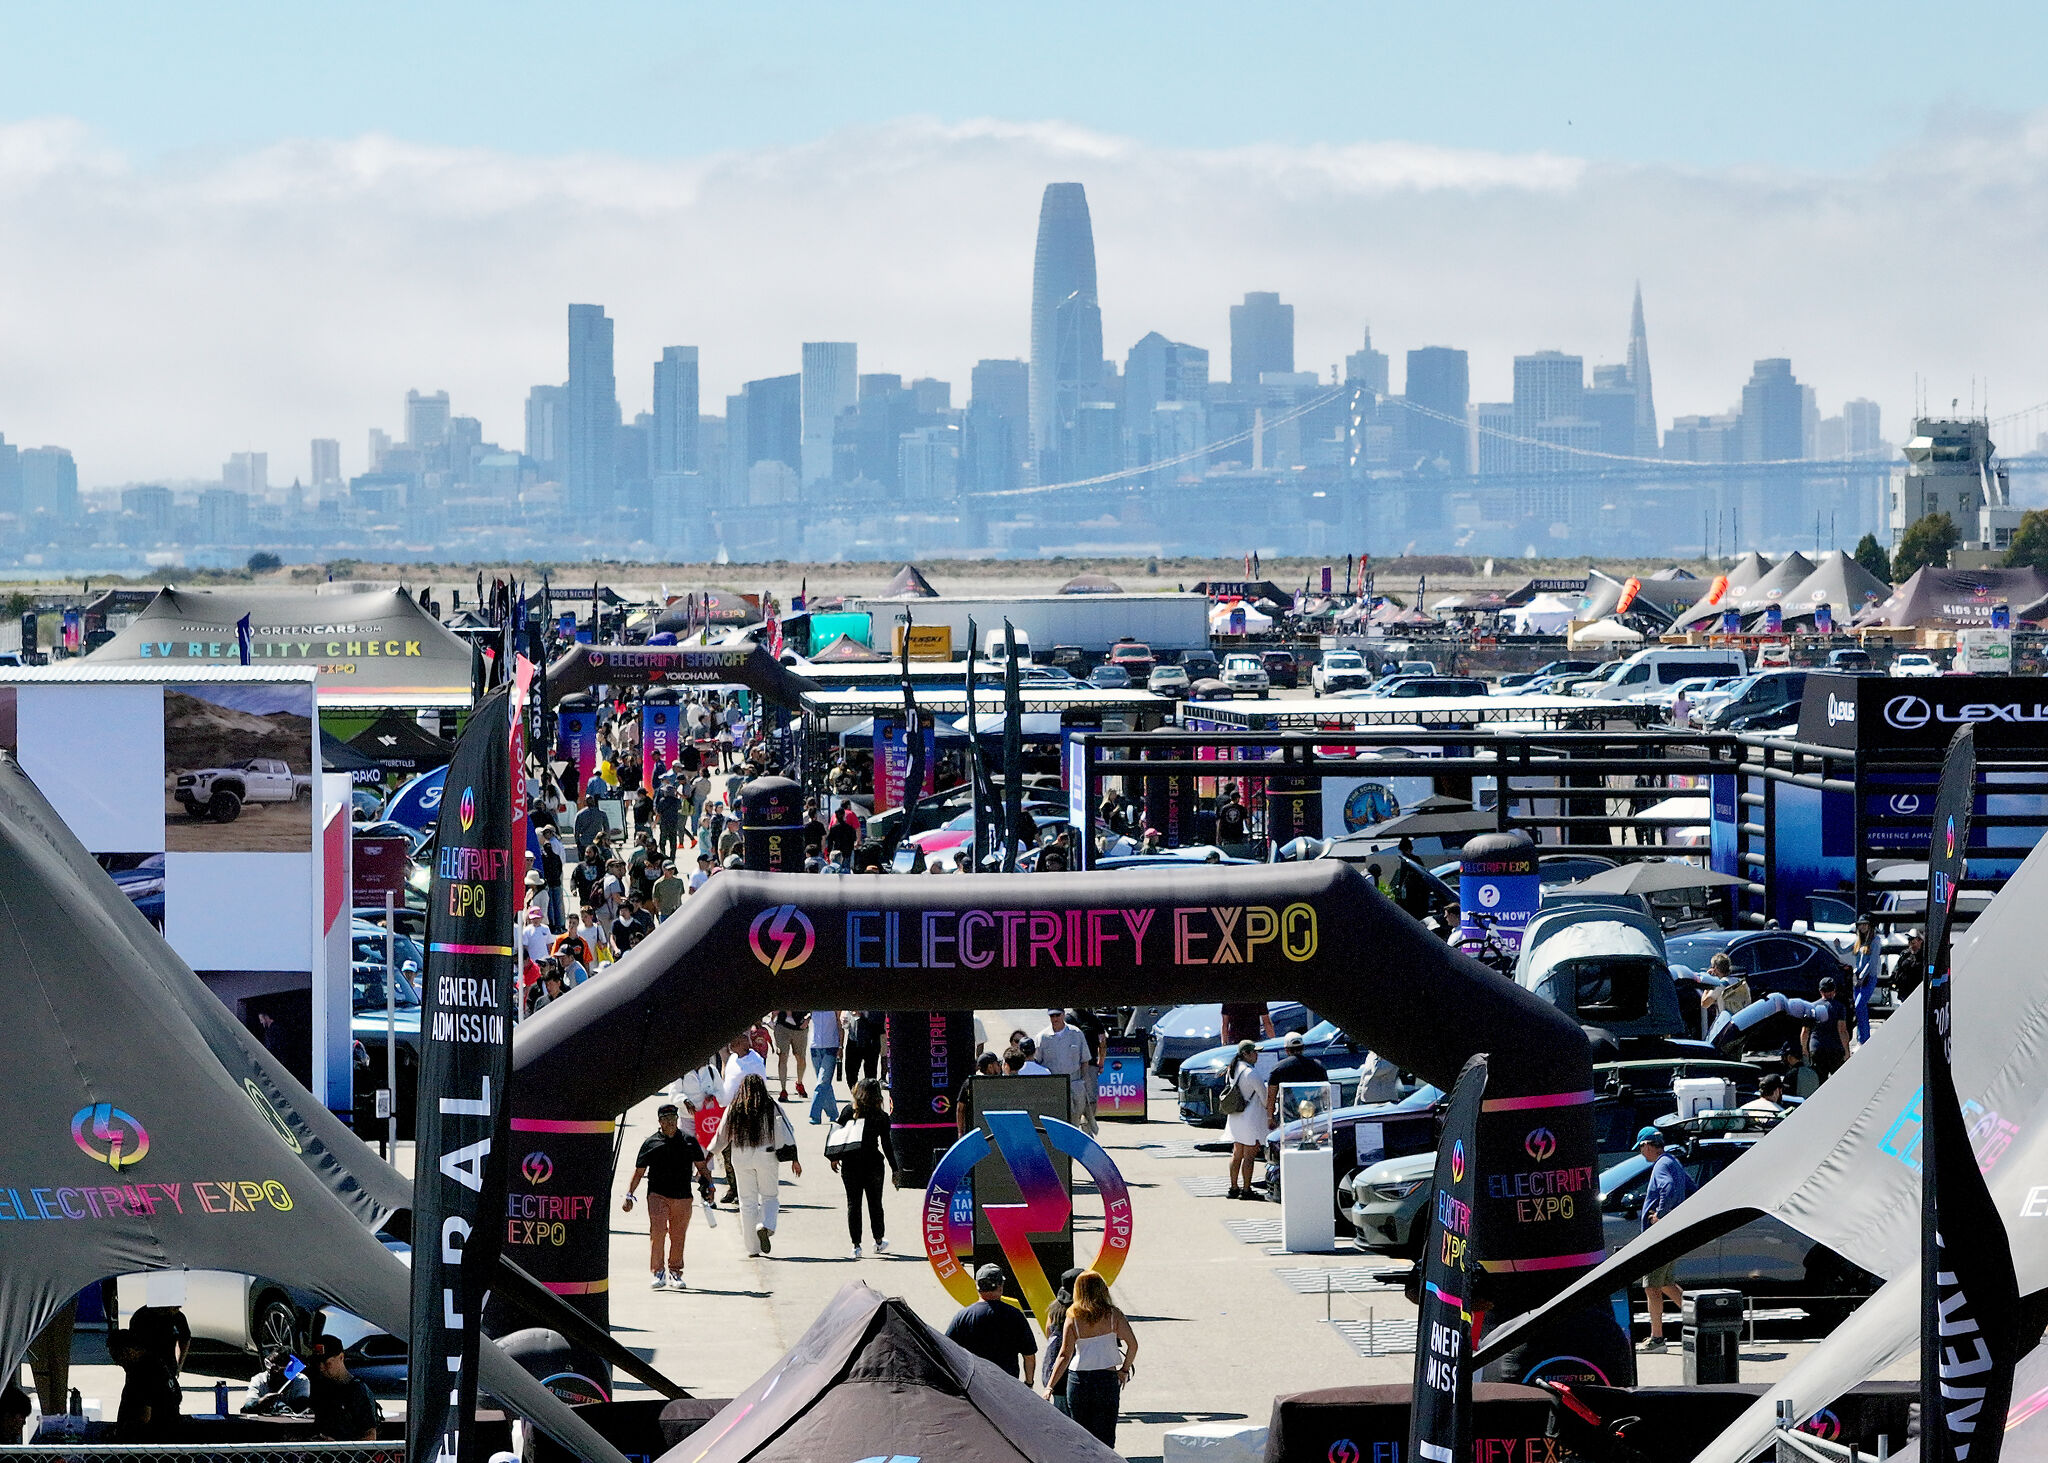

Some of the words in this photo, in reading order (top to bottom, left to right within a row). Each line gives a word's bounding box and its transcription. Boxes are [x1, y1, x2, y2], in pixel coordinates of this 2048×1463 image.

[1943, 605, 1971, 615] KIDS
[260, 625, 383, 635] GREENCARS.COM
[140, 642, 173, 657] EV
[326, 640, 421, 656] CHECK
[609, 653, 678, 667] ELECTRIFY
[687, 653, 748, 667] SHOWOFF
[317, 663, 356, 674] EXPO
[665, 671, 720, 680] YOKOHAMA
[1936, 704, 2048, 722] LEXU
[352, 769, 381, 782] RAKO
[513, 732, 525, 823] TOYOTA
[769, 835, 782, 864] EXPO
[440, 846, 510, 881] ELECTRIFY
[1509, 861, 1530, 872] EXPO
[449, 884, 486, 918] EXPO
[846, 909, 1156, 968] ELECTRIFY
[1173, 902, 1318, 966] EXPO
[438, 976, 498, 1008] GENERAL
[432, 1012, 504, 1045] ADMISSION
[929, 1012, 949, 1088] ELECTRIF
[1099, 1085, 1136, 1097] DEMOS
[1110, 1073, 1124, 1085] EV
[1488, 1166, 1592, 1198] ELECTRIFY
[192, 1179, 294, 1213] EXPO
[507, 1193, 594, 1219] ECTRIFY
[1517, 1195, 1574, 1223] EXPO
[954, 1212, 967, 1222] EV
[1110, 1198, 1129, 1249] EXPO
[508, 1219, 566, 1246] EXPO
[927, 1184, 957, 1279] ELECTRIFY
